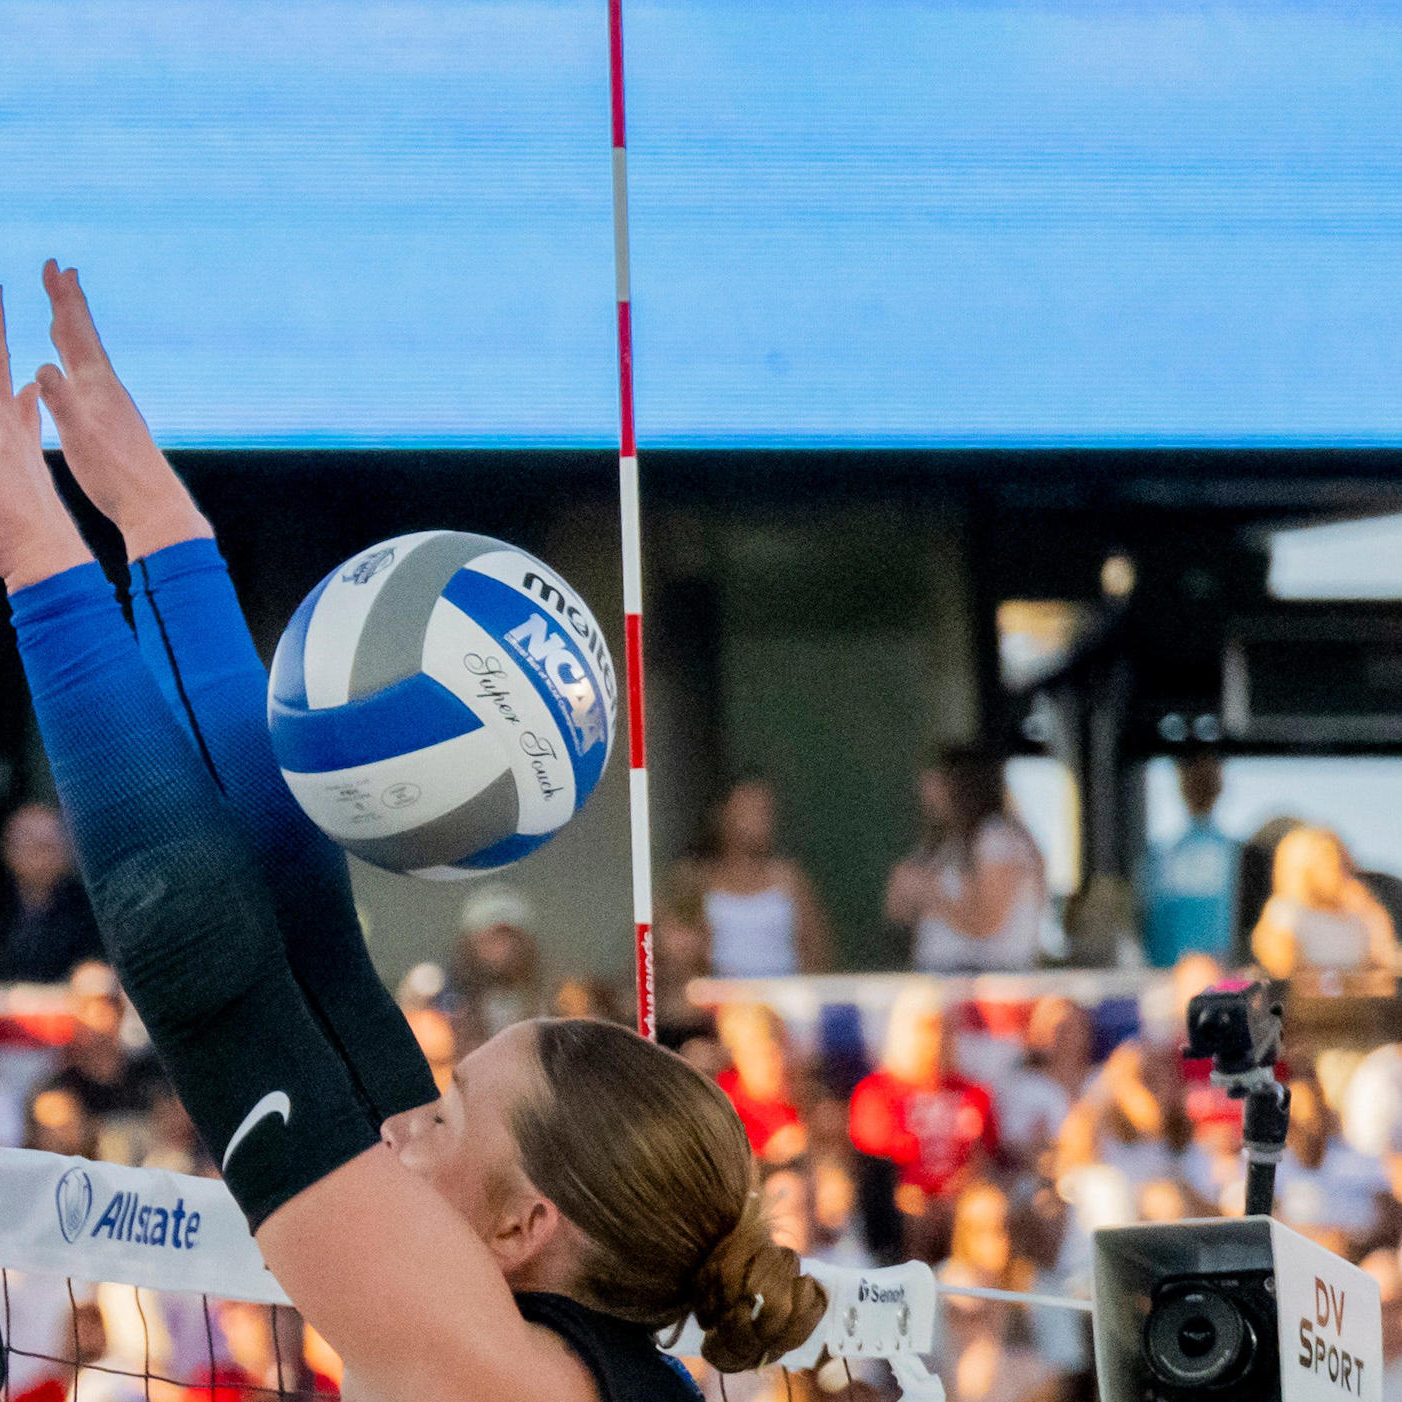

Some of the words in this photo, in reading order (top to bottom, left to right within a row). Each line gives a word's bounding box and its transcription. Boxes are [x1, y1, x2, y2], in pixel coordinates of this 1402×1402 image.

[463, 651, 520, 726] Super
[519, 730, 564, 801] Touch
[1314, 1275, 1345, 1337] DV
[1299, 1317, 1364, 1398] SPORT
